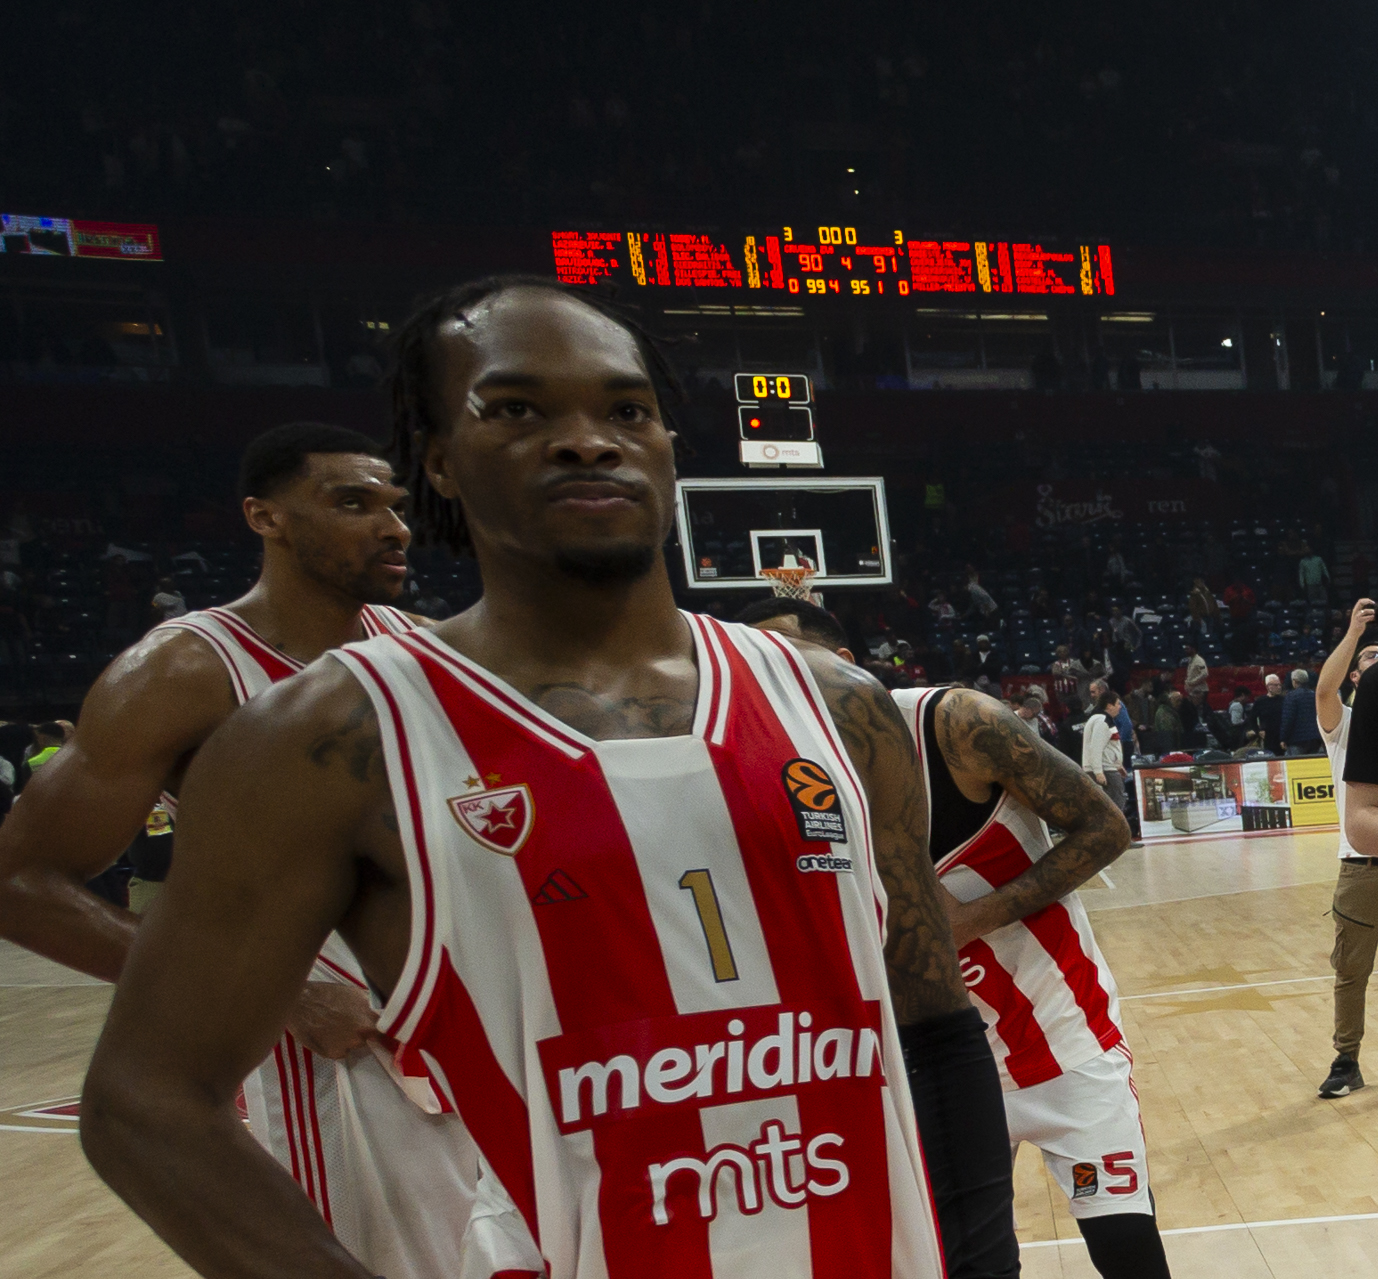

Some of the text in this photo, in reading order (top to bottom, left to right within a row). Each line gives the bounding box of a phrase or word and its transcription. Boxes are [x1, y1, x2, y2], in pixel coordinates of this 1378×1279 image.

[783, 226, 793, 241] 3
[894, 229, 903, 245] 3
[798, 254, 824, 273] 90
[873, 255, 898, 274] 91
[788, 278, 799, 294] 0
[806, 279, 827, 294] 99
[850, 279, 871, 295] 95
[898, 280, 910, 296] 0
[752, 376, 791, 398] 0:0
[461, 801, 484, 814] KK
[800, 811, 841, 822] TURKISH
[805, 820, 843, 832] AIRLINES
[806, 830, 845, 841] EuroLeague
[799, 855, 852, 871] onetea
[679, 868, 739, 984] 1
[558, 1011, 885, 1125] meridian
[649, 1120, 850, 1227] mts
[1104, 1151, 1138, 1195] 5
